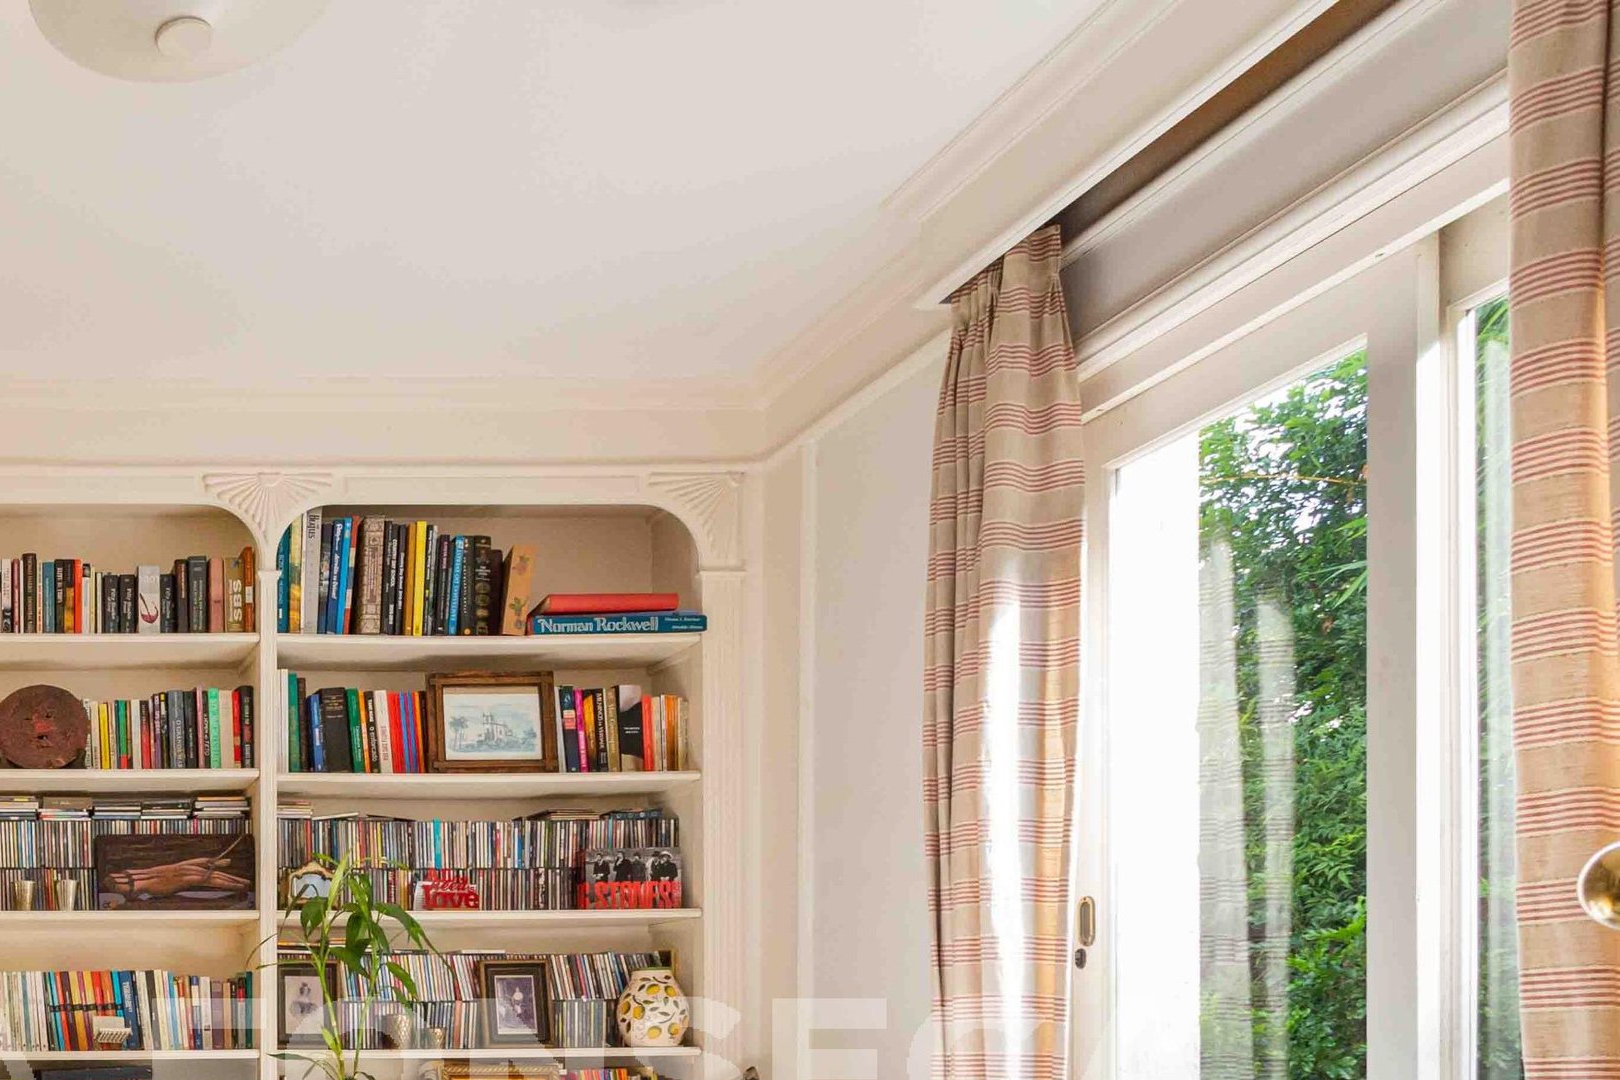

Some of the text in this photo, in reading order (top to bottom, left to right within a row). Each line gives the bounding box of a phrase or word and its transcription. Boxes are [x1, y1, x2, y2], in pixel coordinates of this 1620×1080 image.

[537, 618, 593, 633] Norman
[594, 616, 659, 632] Rockwell
[369, 732, 378, 762] enforcado
